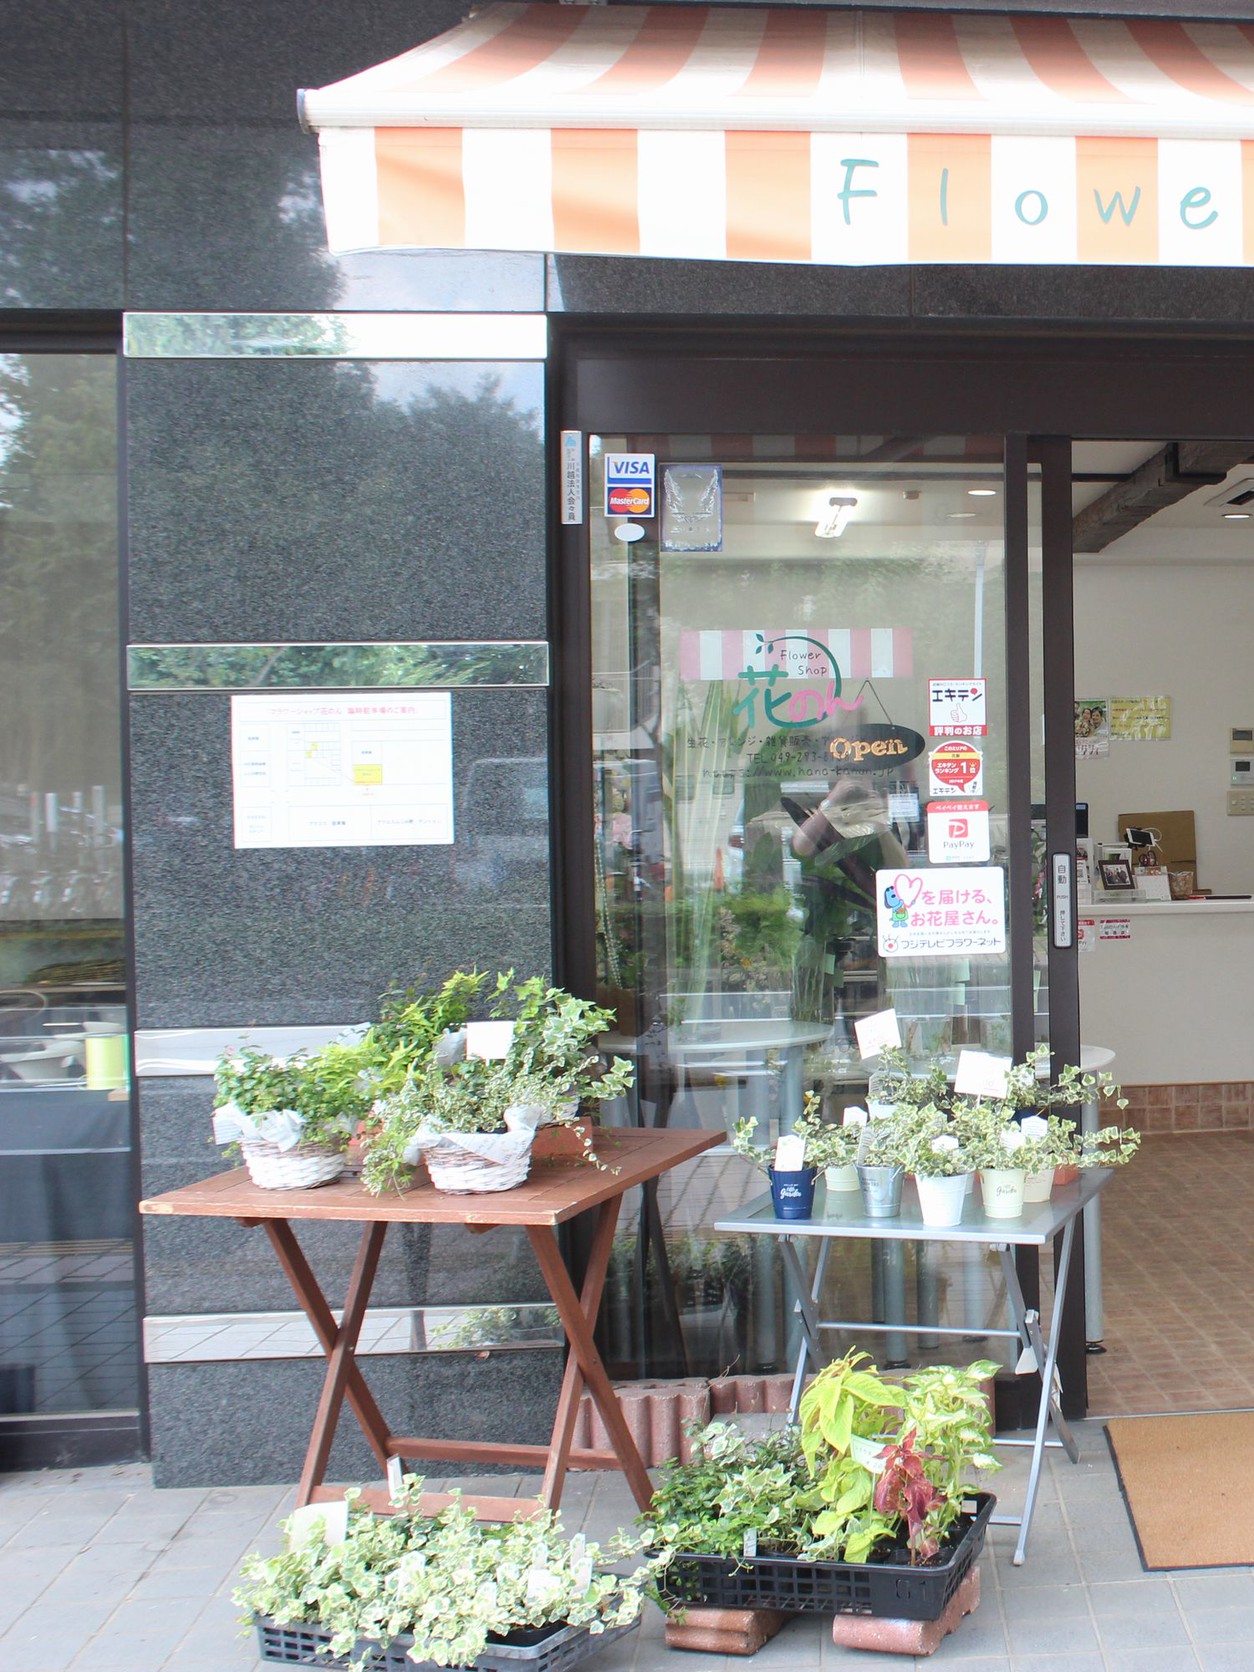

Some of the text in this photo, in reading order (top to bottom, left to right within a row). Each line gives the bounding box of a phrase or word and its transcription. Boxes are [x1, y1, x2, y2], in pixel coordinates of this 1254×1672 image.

[613, 461, 650, 475] VISA
[609, 496, 650, 506] MasterCard
[780, 649, 821, 661] Flower
[797, 665, 828, 677] Shop
[732, 664, 865, 729] 花のん
[932, 687, 983, 702] エキテン
[934, 725, 982, 736] 評判のお店
[829, 737, 908, 762] Open
[746, 753, 767, 764] TEL
[943, 840, 975, 850] PayPay
[1057, 864, 1067, 884] 自動
[920, 889, 993, 905] を届ける、
[910, 910, 999, 927] お花屋さん。
[900, 937, 1001, 950] フジテレビフラワーネット
